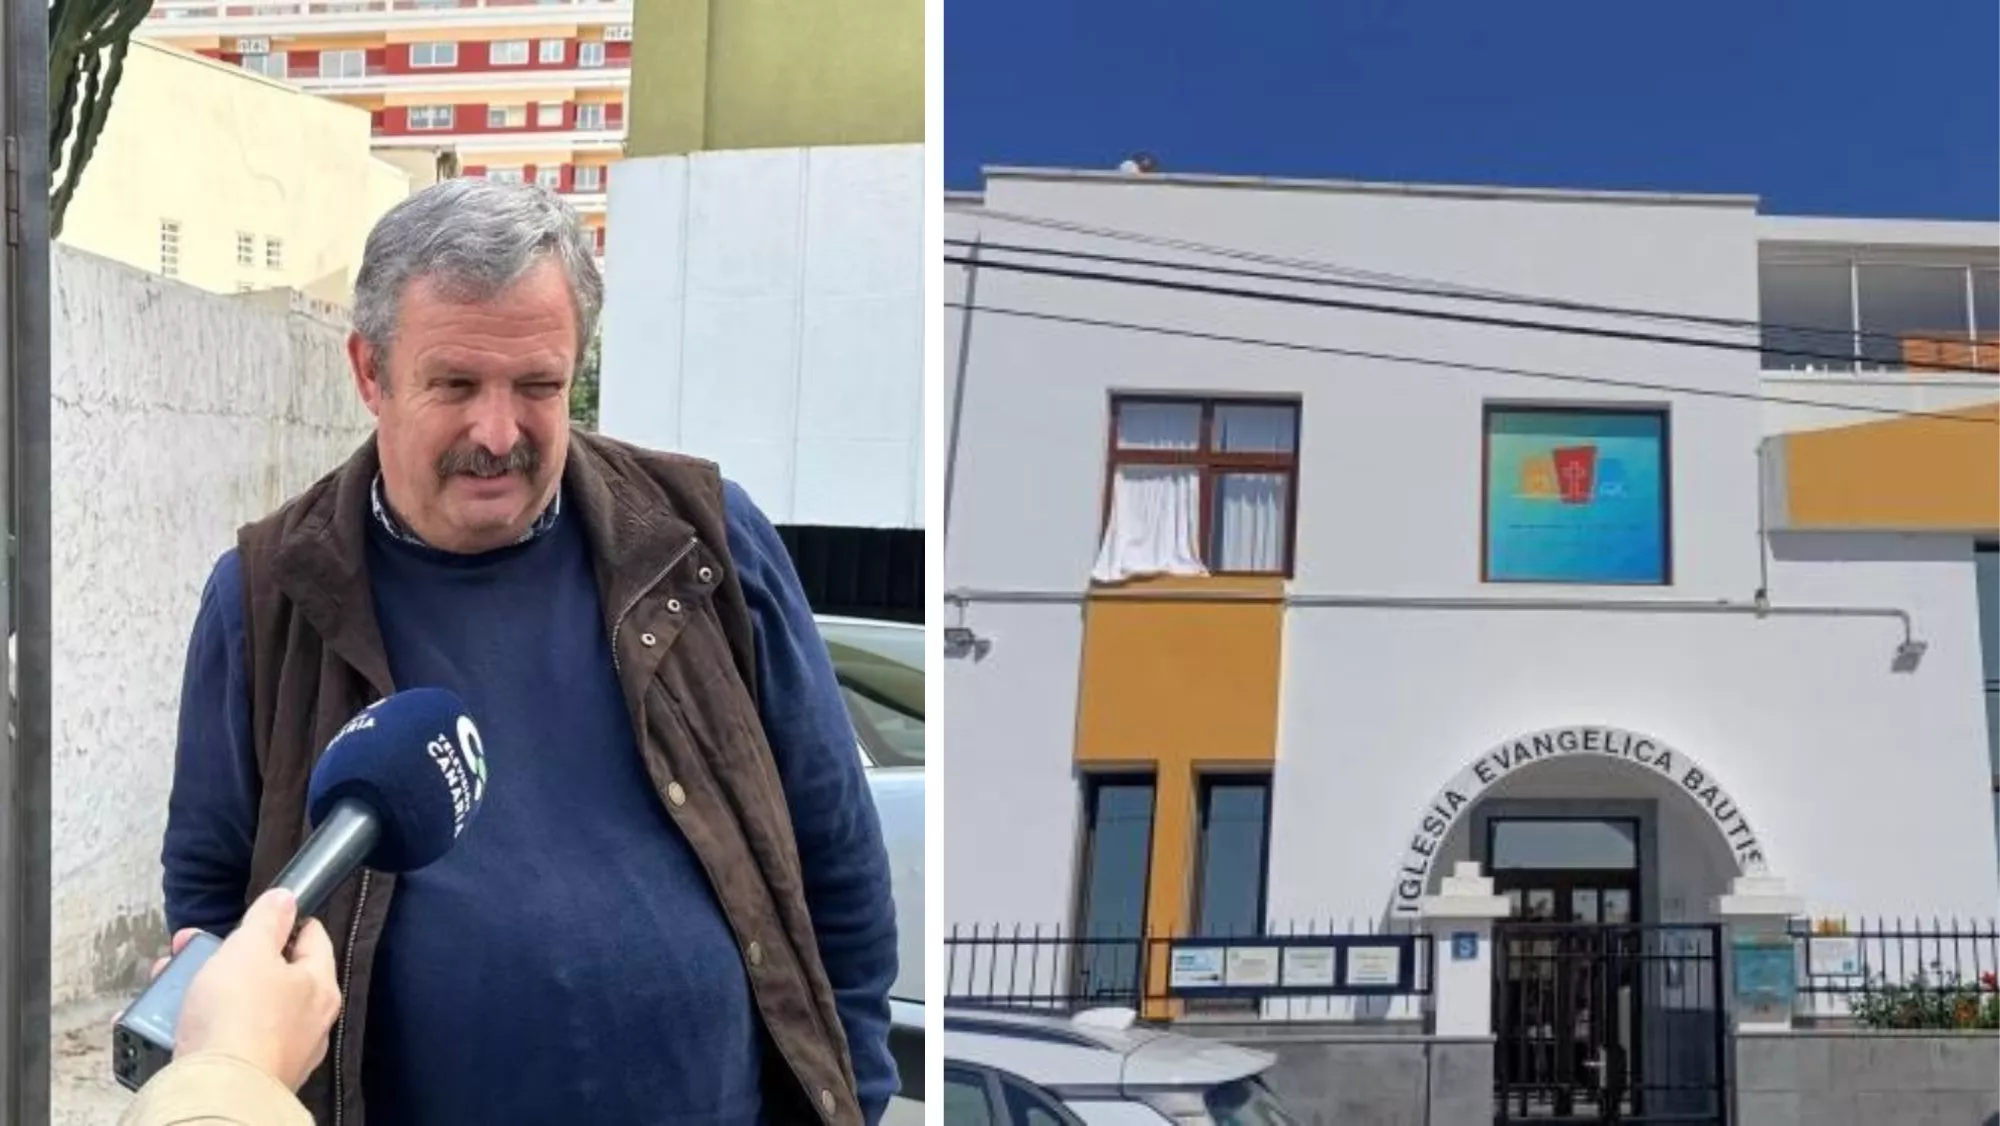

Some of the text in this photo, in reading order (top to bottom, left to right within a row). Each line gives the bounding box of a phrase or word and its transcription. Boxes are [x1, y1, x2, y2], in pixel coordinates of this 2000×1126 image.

[427, 741, 464, 839] CANARIA
[1397, 729, 1762, 912] IGLESIA EVANGELICA BAUTIS
